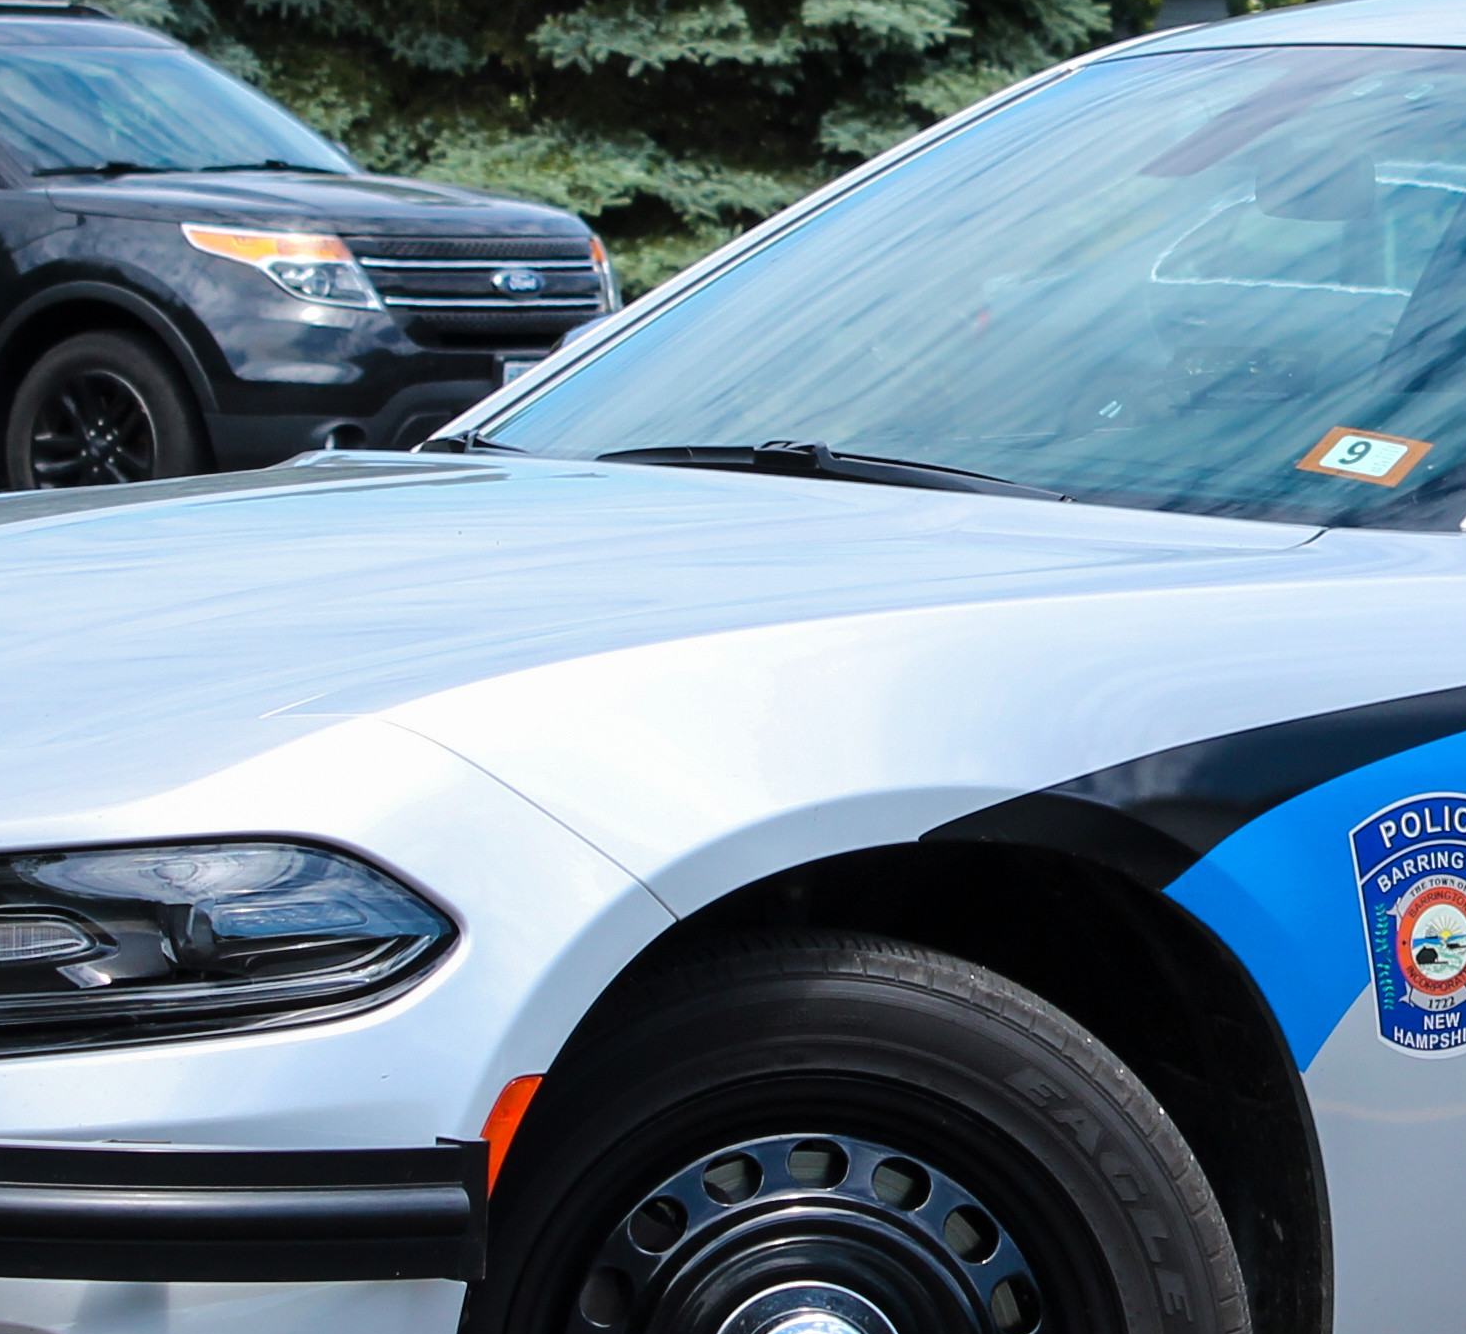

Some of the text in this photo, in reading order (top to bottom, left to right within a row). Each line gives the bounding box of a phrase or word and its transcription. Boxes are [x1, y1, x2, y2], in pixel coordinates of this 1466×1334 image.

[1338, 440, 1372, 465] 9
[1410, 882, 1425, 897] THE
[1429, 879, 1454, 887] TOWN
[1429, 997, 1455, 1009] 1722
[1424, 1012, 1460, 1030] NEW
[1001, 1066, 1195, 1325] EAGLE
